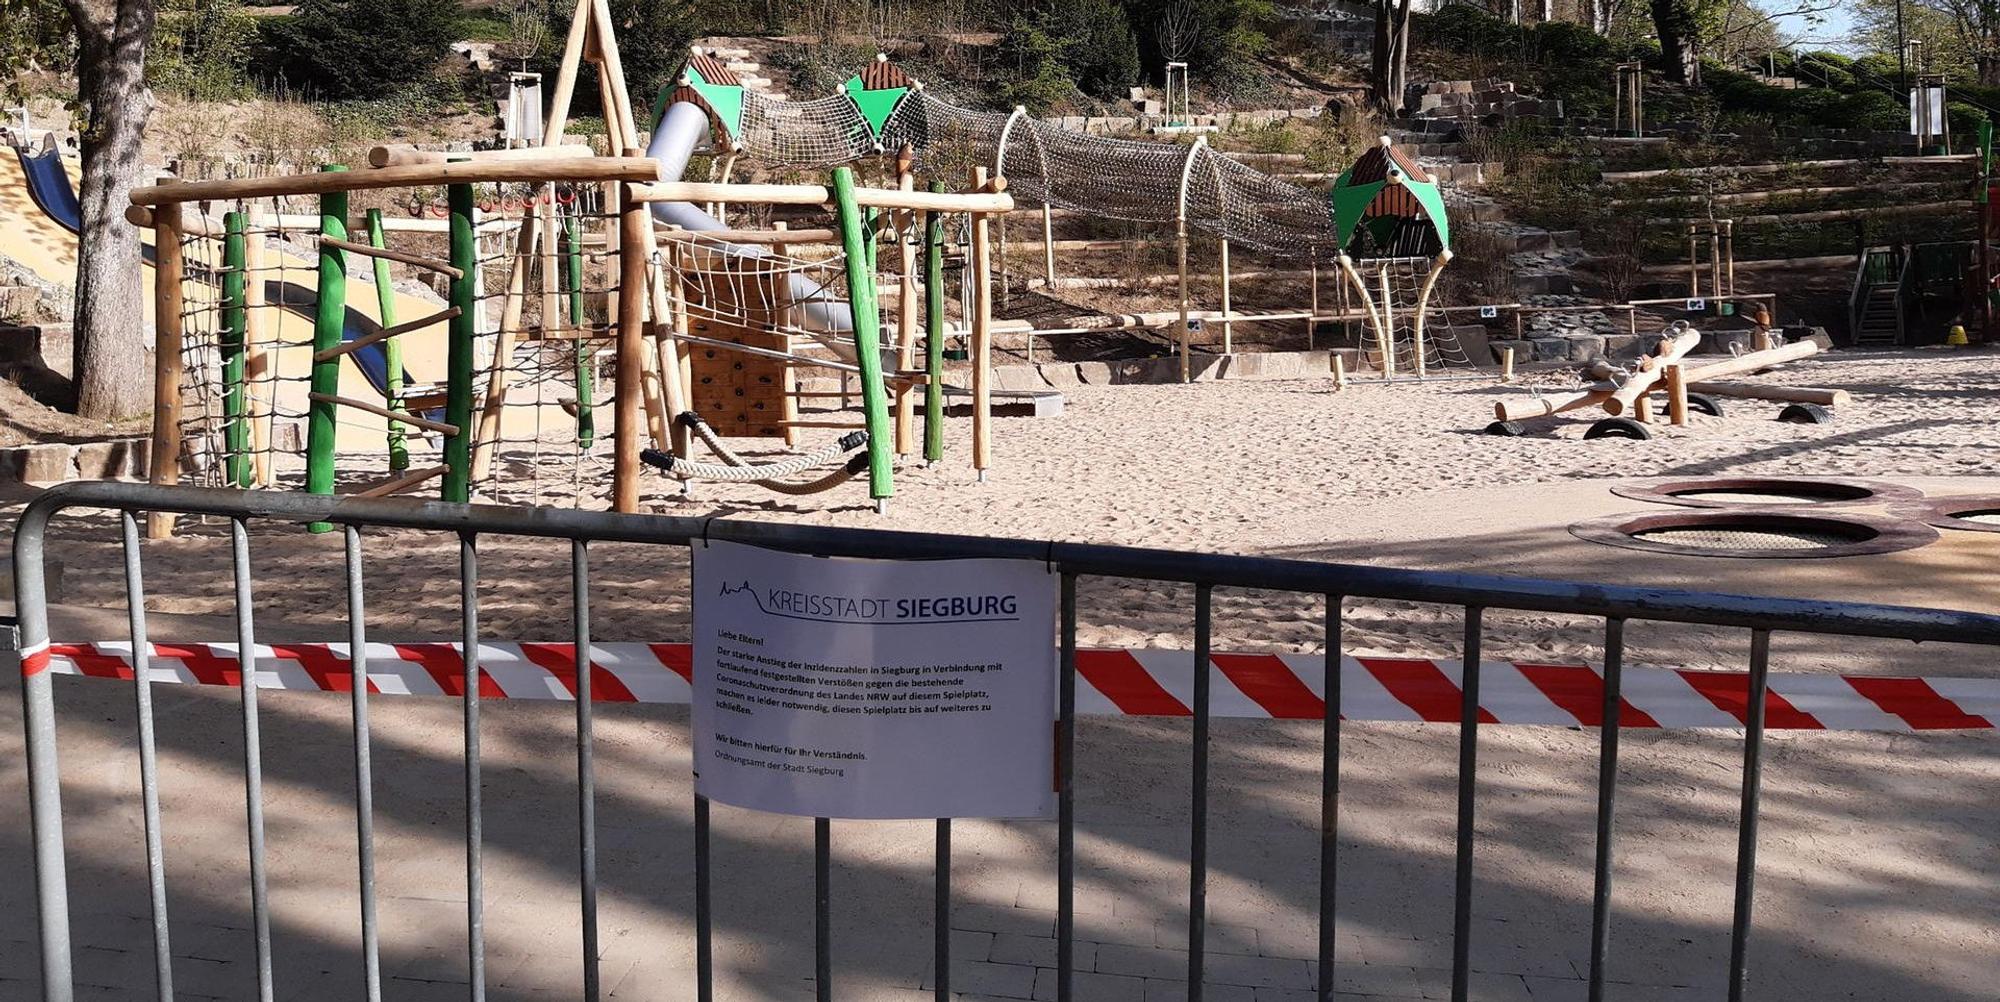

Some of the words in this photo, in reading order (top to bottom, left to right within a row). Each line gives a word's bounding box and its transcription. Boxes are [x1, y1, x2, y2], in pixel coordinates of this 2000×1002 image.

[768, 588, 891, 618] KREISSTADT
[896, 595, 1017, 618] SIEGBURG
[717, 629, 737, 641] Liebe
[738, 634, 764, 646] Eltern!
[716, 659, 759, 676] fortlaufend
[760, 668, 816, 684] festgestellten
[818, 676, 864, 688] Verstößen
[865, 680, 893, 689] gegen
[895, 678, 909, 688] die
[911, 677, 964, 688] bestehende
[717, 646, 731, 656] Der
[732, 650, 755, 662] starke
[757, 655, 786, 669] Anstieg
[787, 660, 802, 669] der
[804, 662, 868, 674] Inzidenzzahlen
[870, 666, 880, 674] in
[881, 666, 921, 676] Siegburg
[922, 665, 932, 673] in
[933, 663, 985, 673] Verbindung
[987, 663, 1002, 671] mit
[716, 673, 815, 699] Coronaschutzverordnung
[816, 690, 831, 699] des
[834, 691, 864, 701] Landes
[866, 692, 890, 701] NRW
[892, 691, 907, 700] auf
[909, 691, 941, 700] diesem
[943, 690, 989, 700] Spielplatz,
[715, 700, 753, 715] schließen.
[716, 687, 745, 700] machen
[757, 696, 780, 708] leider
[832, 704, 861, 714] diesen
[863, 705, 907, 716] Spielplatz
[909, 705, 922, 714] bis
[924, 704, 939, 713] auf
[941, 704, 979, 713] weiteres
[981, 704, 992, 713] zu
[715, 732, 729, 743] Wir
[730, 736, 753, 749] bitten
[754, 741, 783, 754] hierfür
[784, 746, 798, 756] für
[799, 749, 811, 757] Ihr
[813, 749, 868, 760] Verständnis.
[714, 750, 766, 769] Ordnungsamt
[767, 761, 781, 769] der
[783, 763, 805, 773] Stadt
[807, 765, 844, 776] Siegburg
